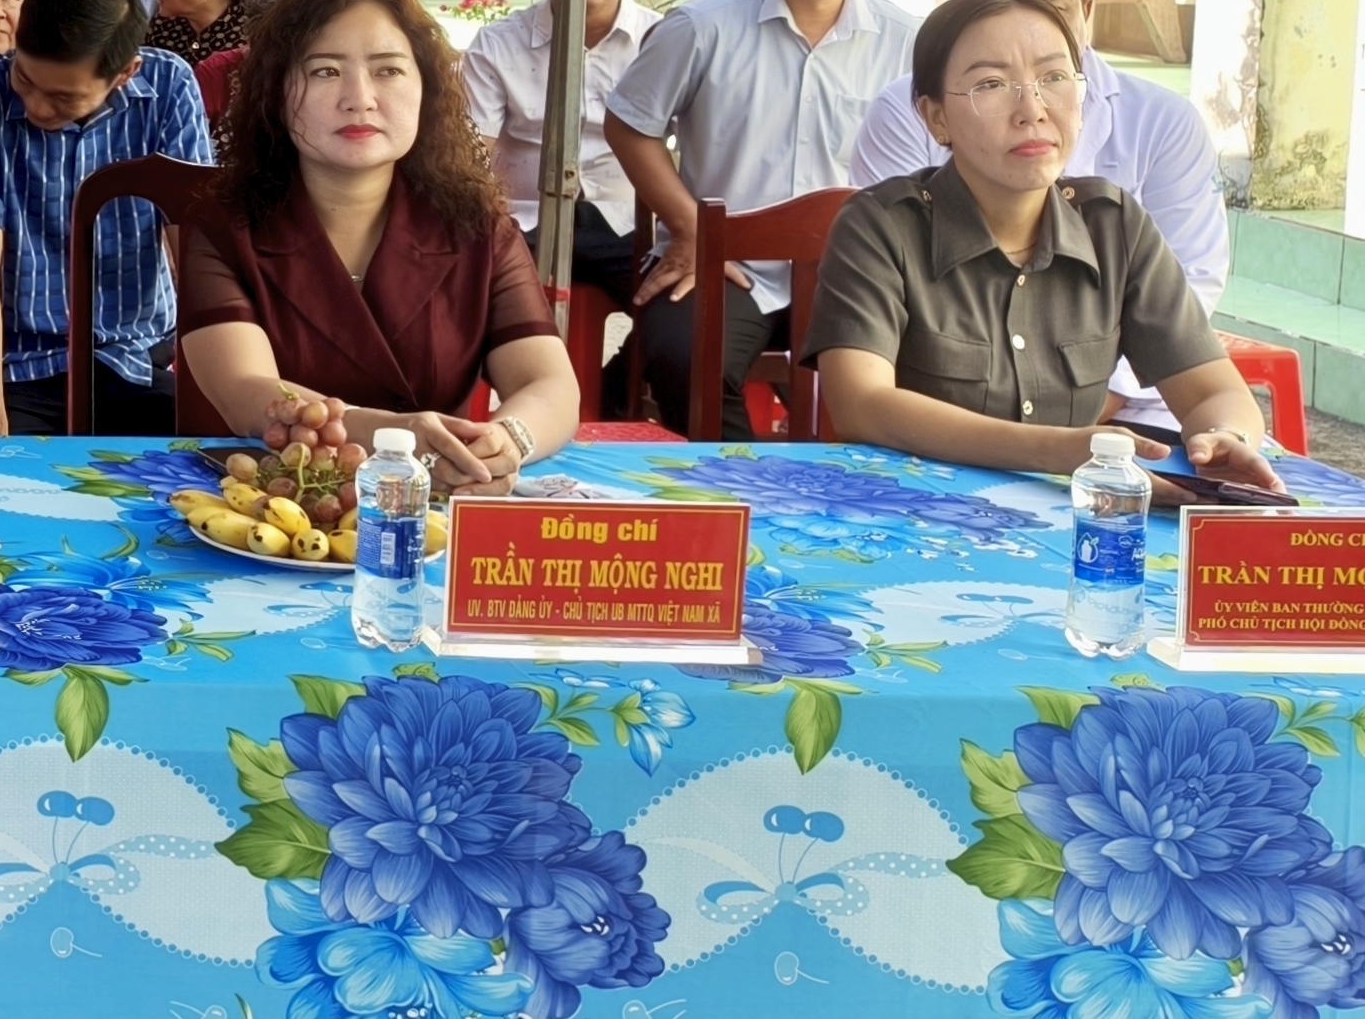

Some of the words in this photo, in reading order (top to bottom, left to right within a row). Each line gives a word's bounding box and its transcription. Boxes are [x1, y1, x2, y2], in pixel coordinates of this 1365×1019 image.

[540, 514, 608, 544] Đồng
[618, 519, 659, 541] chí
[471, 542, 535, 586] TRẦN
[541, 558, 582, 593] THỊ
[588, 554, 657, 594] MỘNG
[664, 561, 723, 591] NGHI
[1198, 560, 1271, 585] TRẦN
[1277, 566, 1325, 590] THỊ
[468, 599, 483, 617] UV.
[487, 599, 506, 618] BTV
[508, 594, 536, 618] ĐẢNG
[539, 594, 553, 619] ỦY
[563, 595, 583, 620] CHỦ
[586, 602, 609, 623] TỊCH
[611, 602, 624, 621] UB
[627, 603, 655, 623] MTTQ
[657, 599, 680, 626] VIỆT
[682, 604, 705, 623] NAM
[707, 601, 721, 623] XÃ
[1214, 599, 1233, 613] ỦY
[1236, 600, 1269, 613] VIÊN
[1272, 602, 1300, 613] BAN
[1303, 600, 1364, 614] THƯỜNG
[1198, 615, 1227, 629] PHÓ
[1230, 615, 1260, 629] CHỦ
[1262, 618, 1296, 631] TỊCH
[1299, 617, 1325, 632] HỘI
